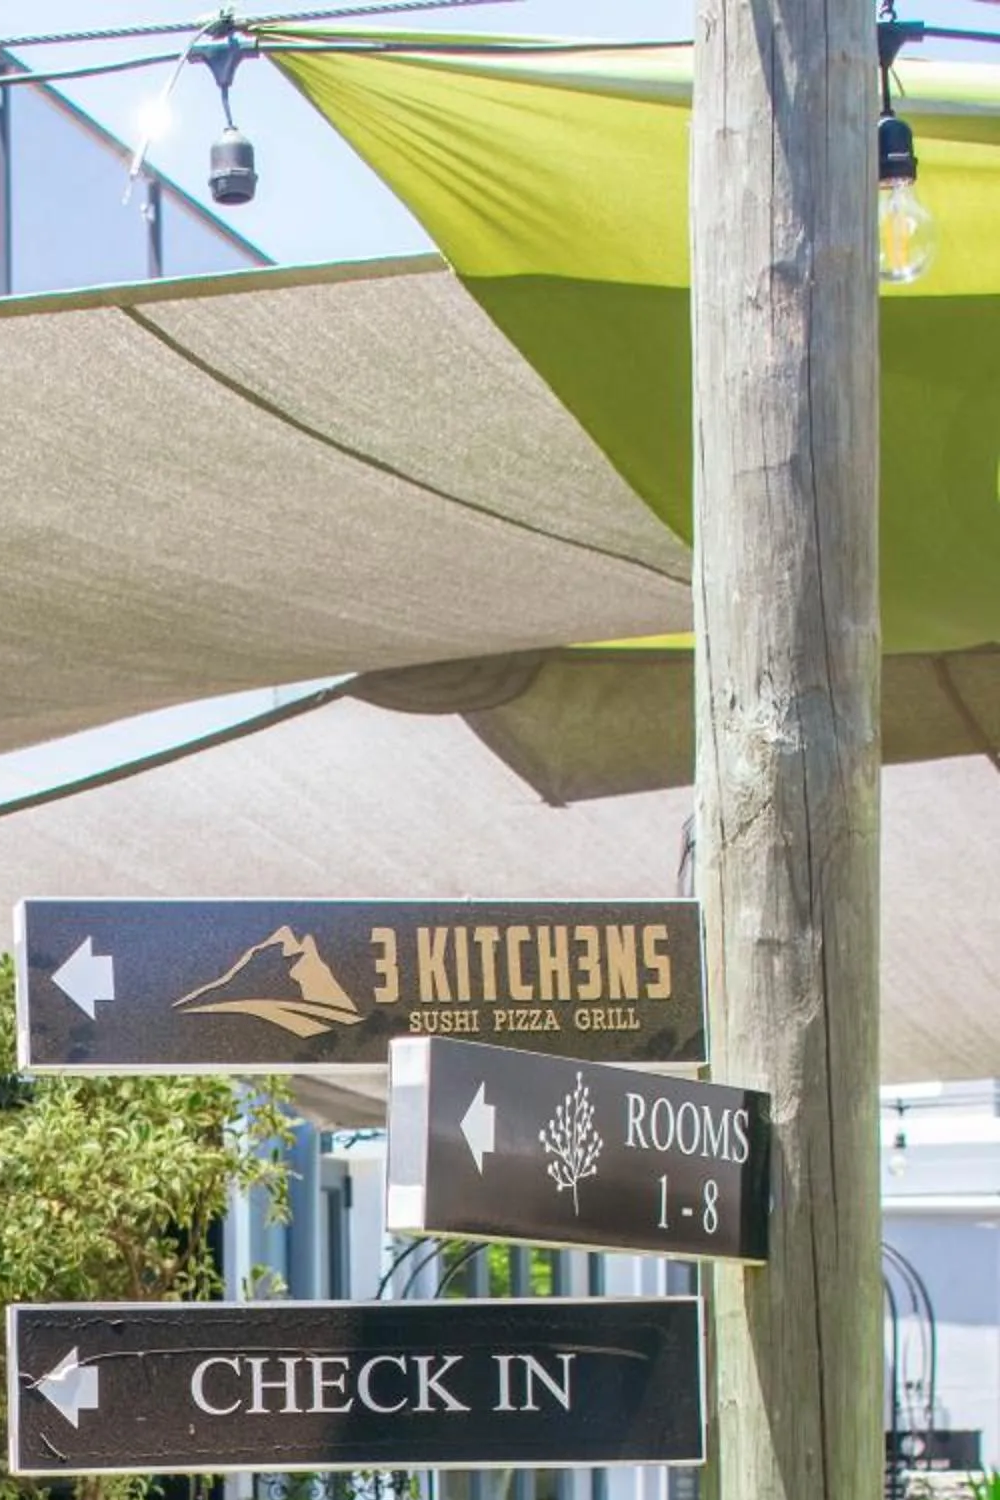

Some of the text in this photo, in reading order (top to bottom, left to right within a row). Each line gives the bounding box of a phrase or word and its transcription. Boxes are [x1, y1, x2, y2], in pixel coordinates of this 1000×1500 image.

[369, 924, 673, 1003] 3 KITCH3NS
[408, 1006, 640, 1033] SUSHI PIZZA GRILL
[624, 1092, 750, 1165] ROOMS
[190, 1353, 576, 1416] CHECK IN
